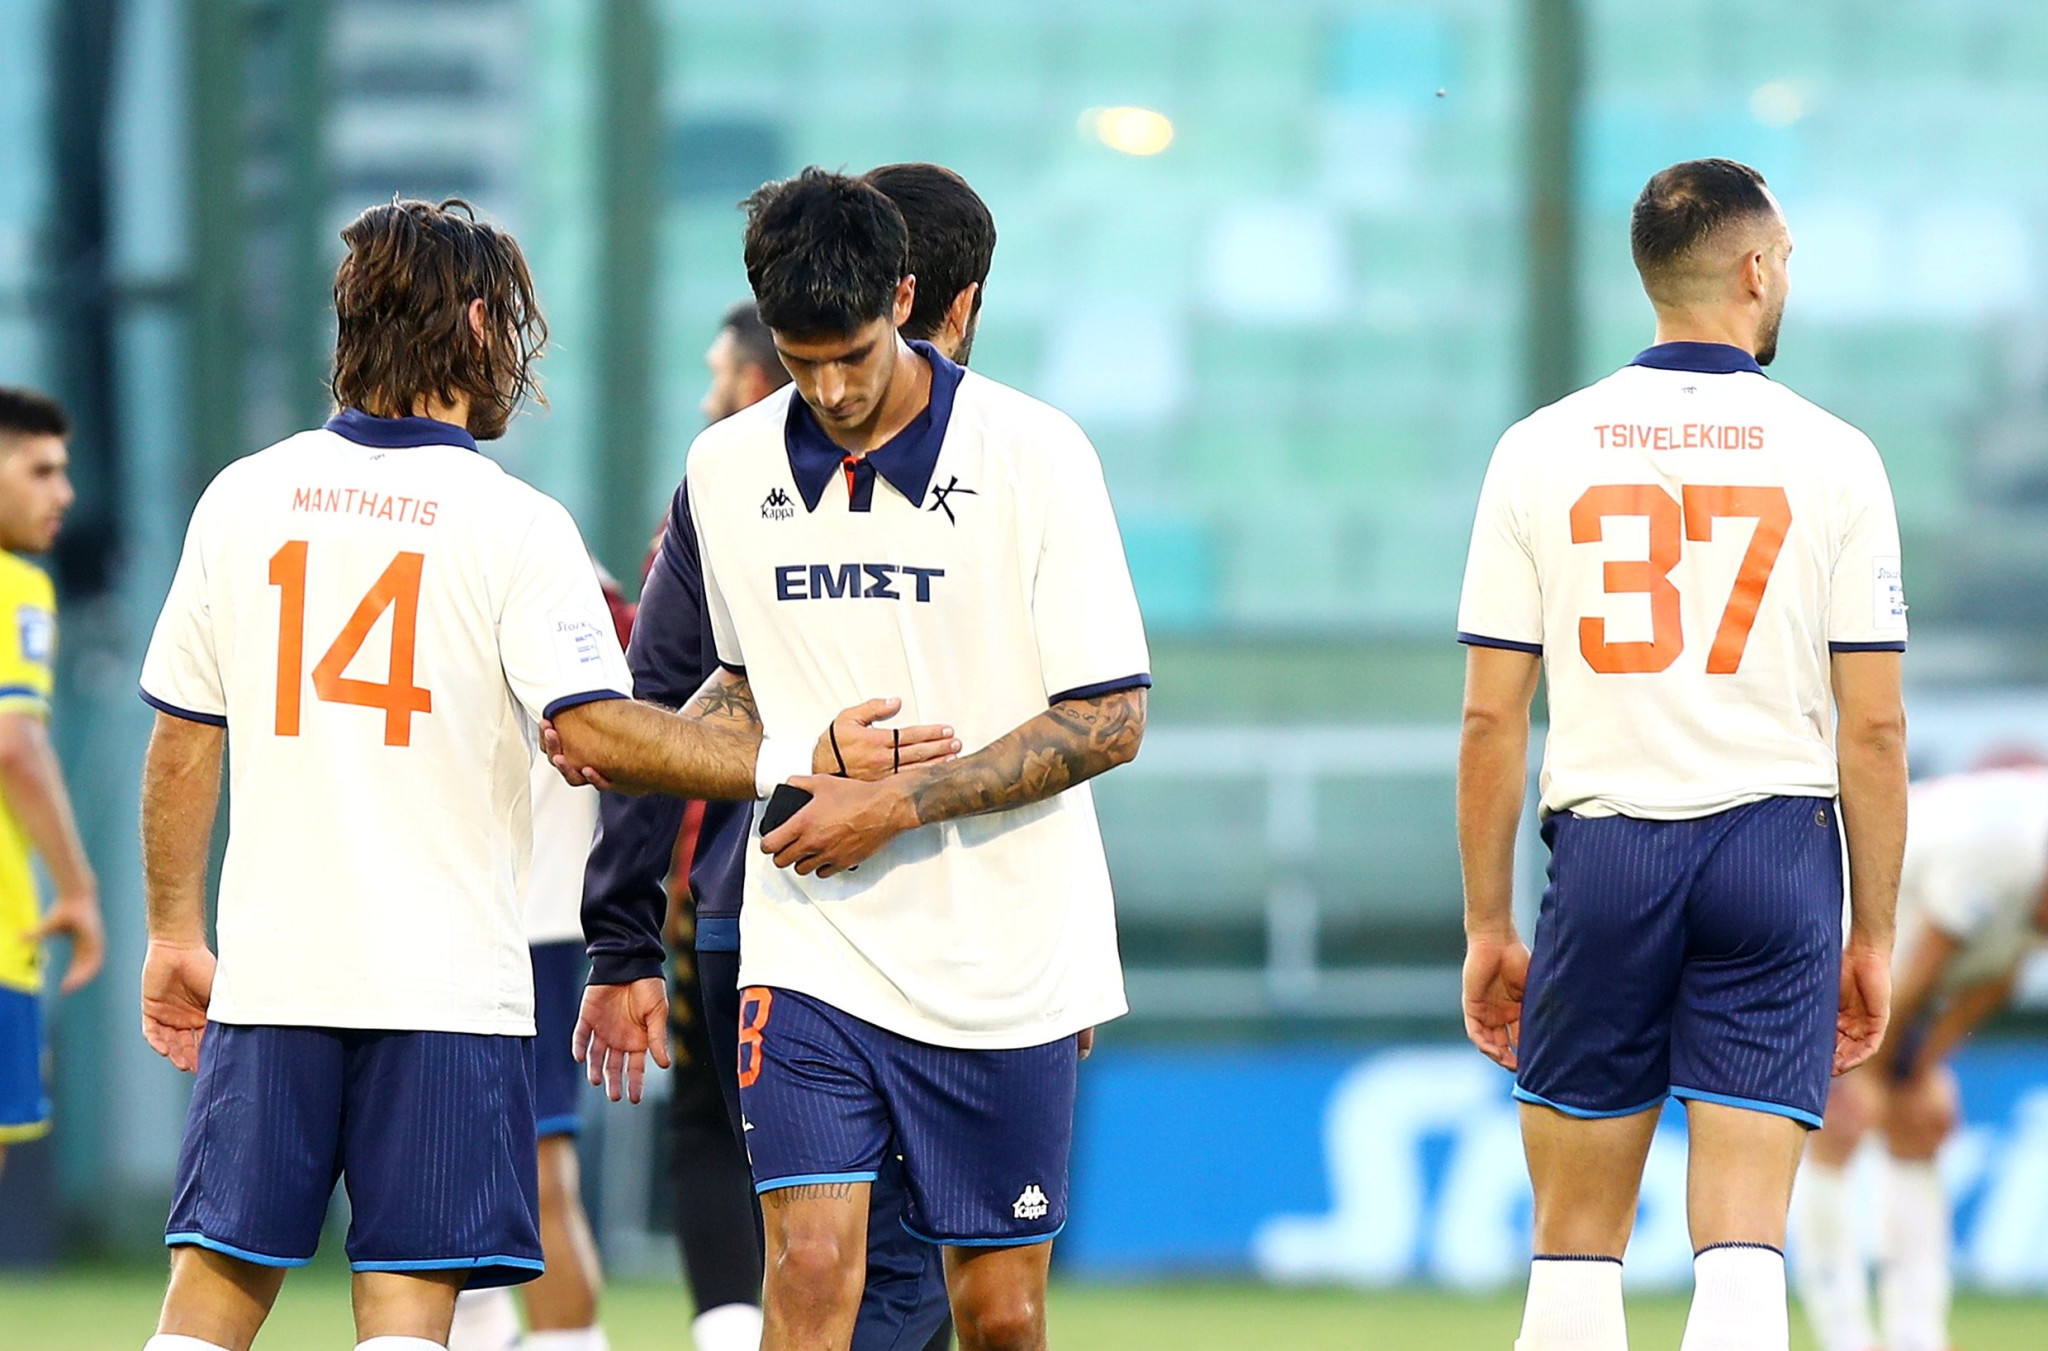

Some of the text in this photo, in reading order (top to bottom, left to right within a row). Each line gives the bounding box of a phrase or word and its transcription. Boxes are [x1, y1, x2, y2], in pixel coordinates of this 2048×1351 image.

[1594, 424, 1764, 450] TSIVELEKIDIS
[293, 487, 438, 526] MANTHATIS
[761, 506, 795, 521] Kappa
[775, 563, 945, 602] ΕΜΣΤ
[1570, 484, 1792, 674] 37
[269, 540, 432, 747] 14
[1014, 1203, 1048, 1220] Kappa
